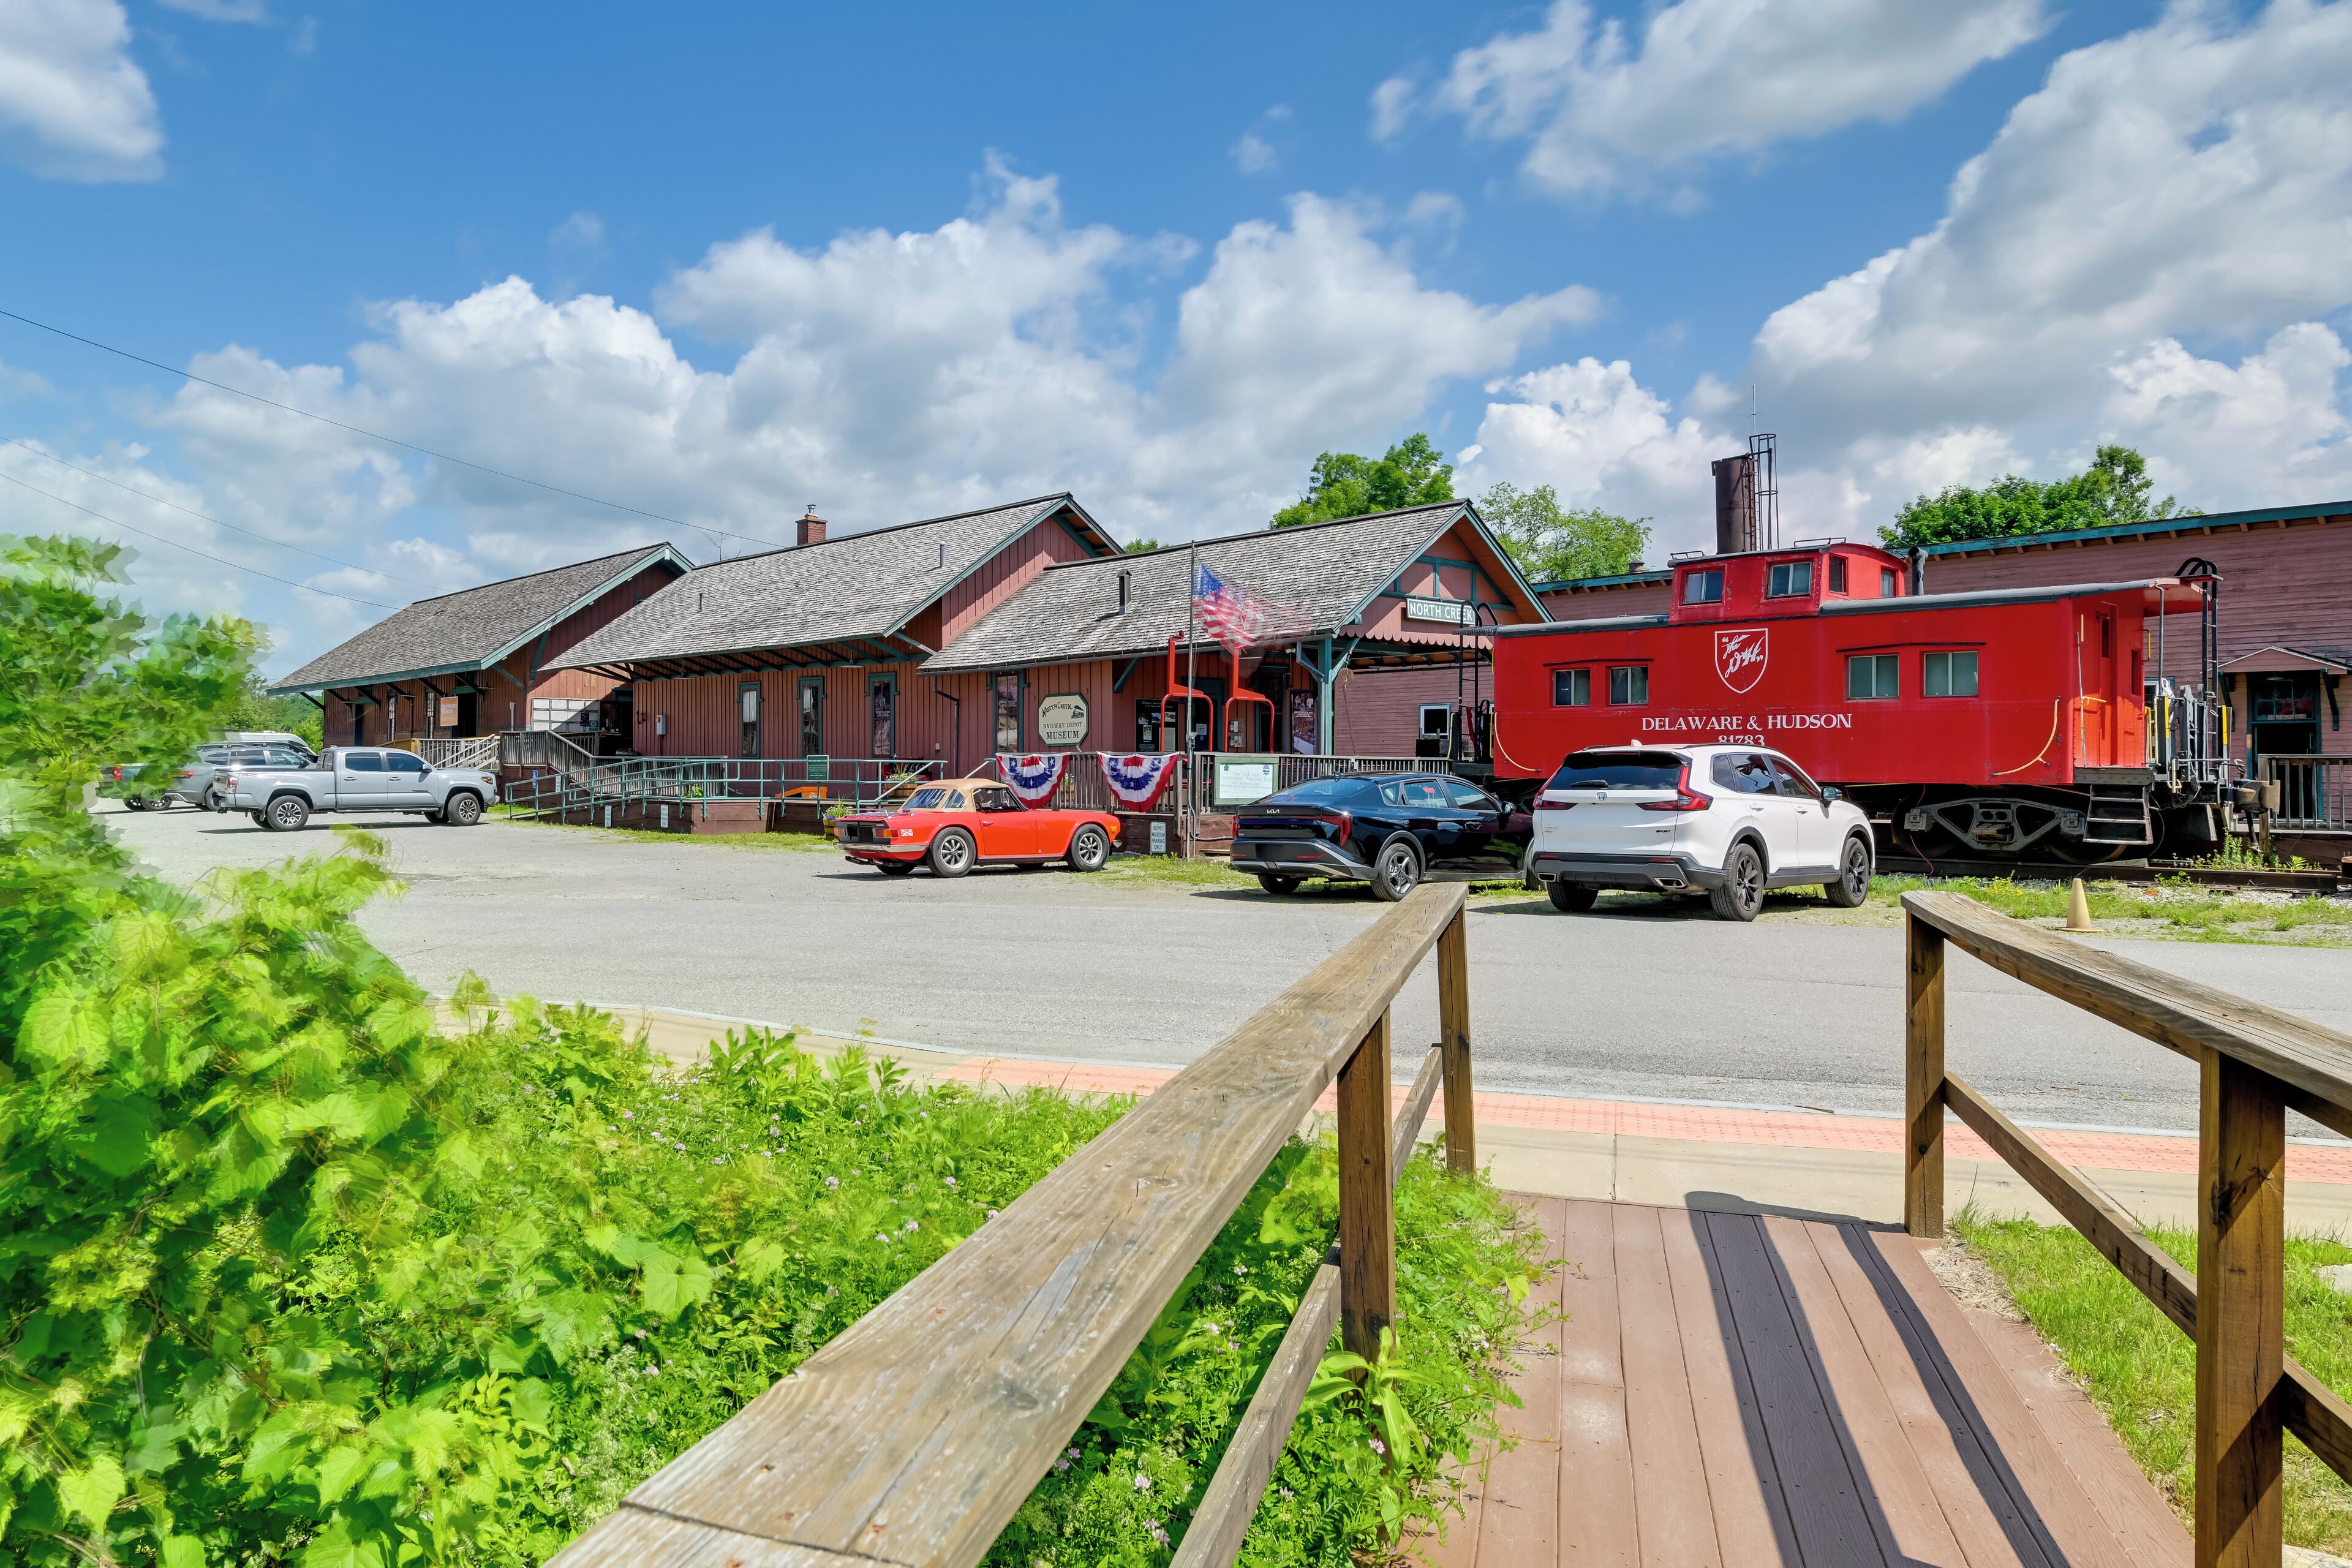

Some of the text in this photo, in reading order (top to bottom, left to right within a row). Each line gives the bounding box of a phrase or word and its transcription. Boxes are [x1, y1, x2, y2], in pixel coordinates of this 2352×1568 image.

[1409, 602, 1473, 621] NORTH CREEK
[1642, 714, 1853, 731] DELAWARE & HUDSON
[1046, 731, 1079, 739] MUSEUM
[1718, 734, 1765, 746] 81783
